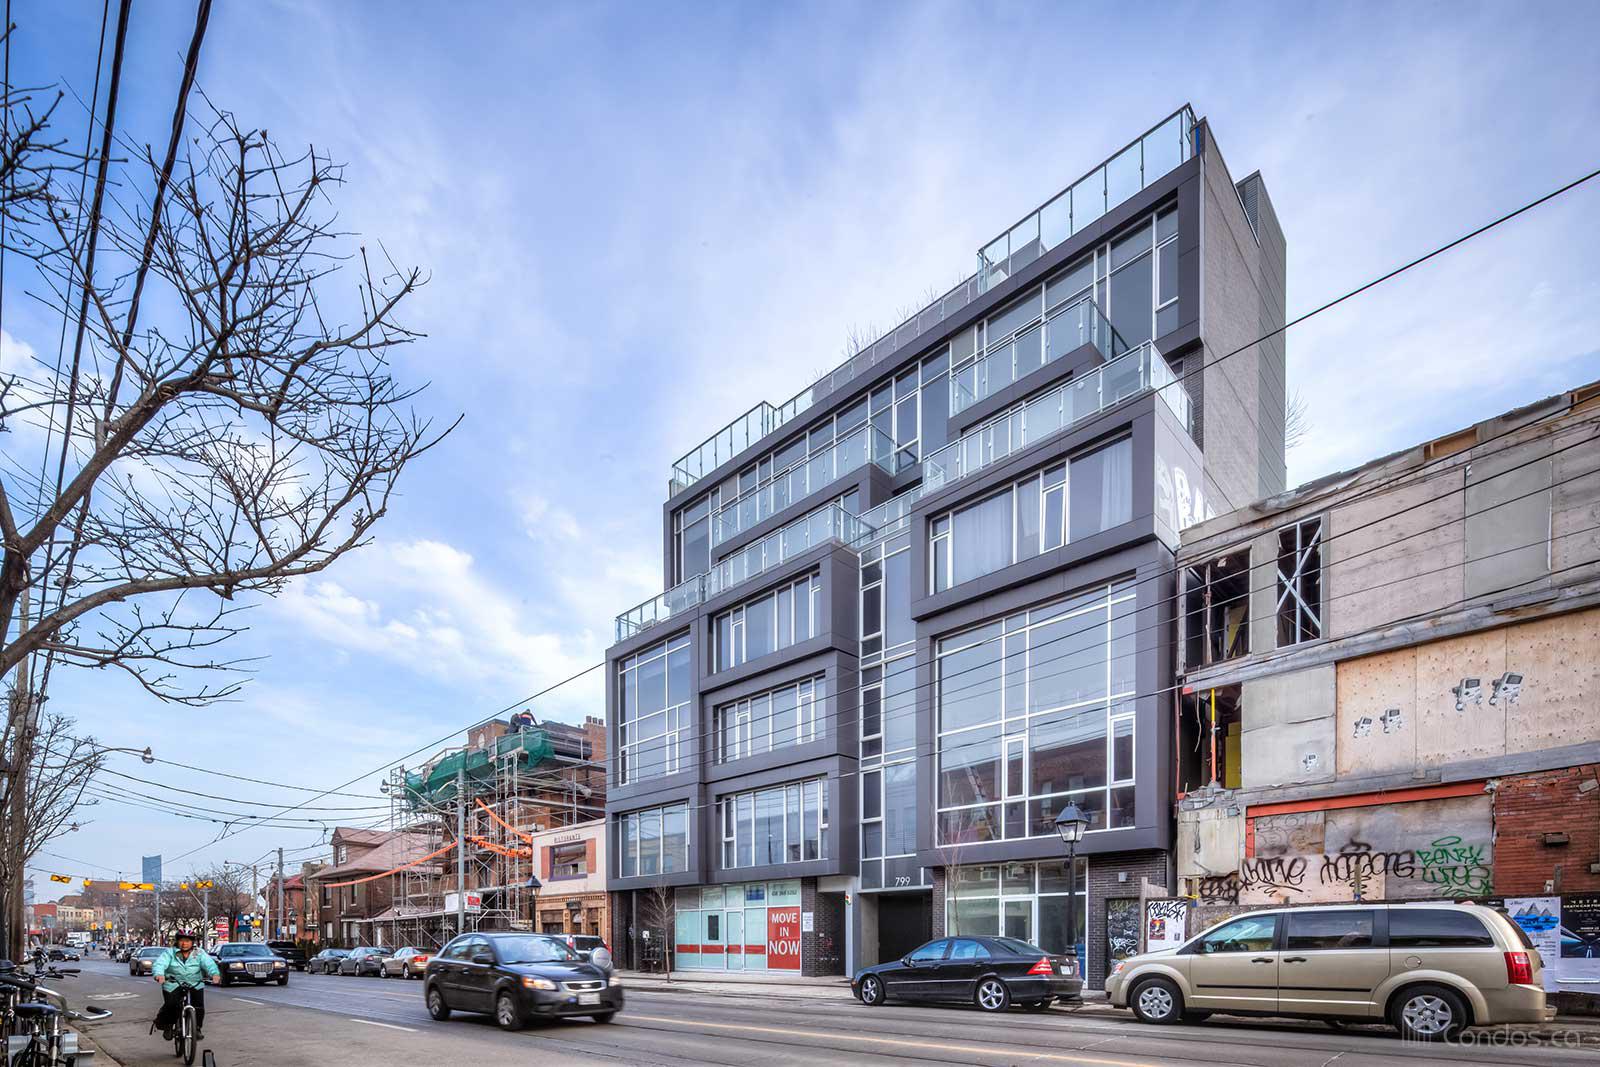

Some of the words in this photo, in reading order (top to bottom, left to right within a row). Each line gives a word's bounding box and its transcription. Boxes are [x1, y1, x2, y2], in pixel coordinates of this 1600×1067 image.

[895, 876, 911, 887] 799
[771, 912, 798, 924] MOVE
[780, 926, 790, 937] IN
[768, 940, 800, 955] NOW
